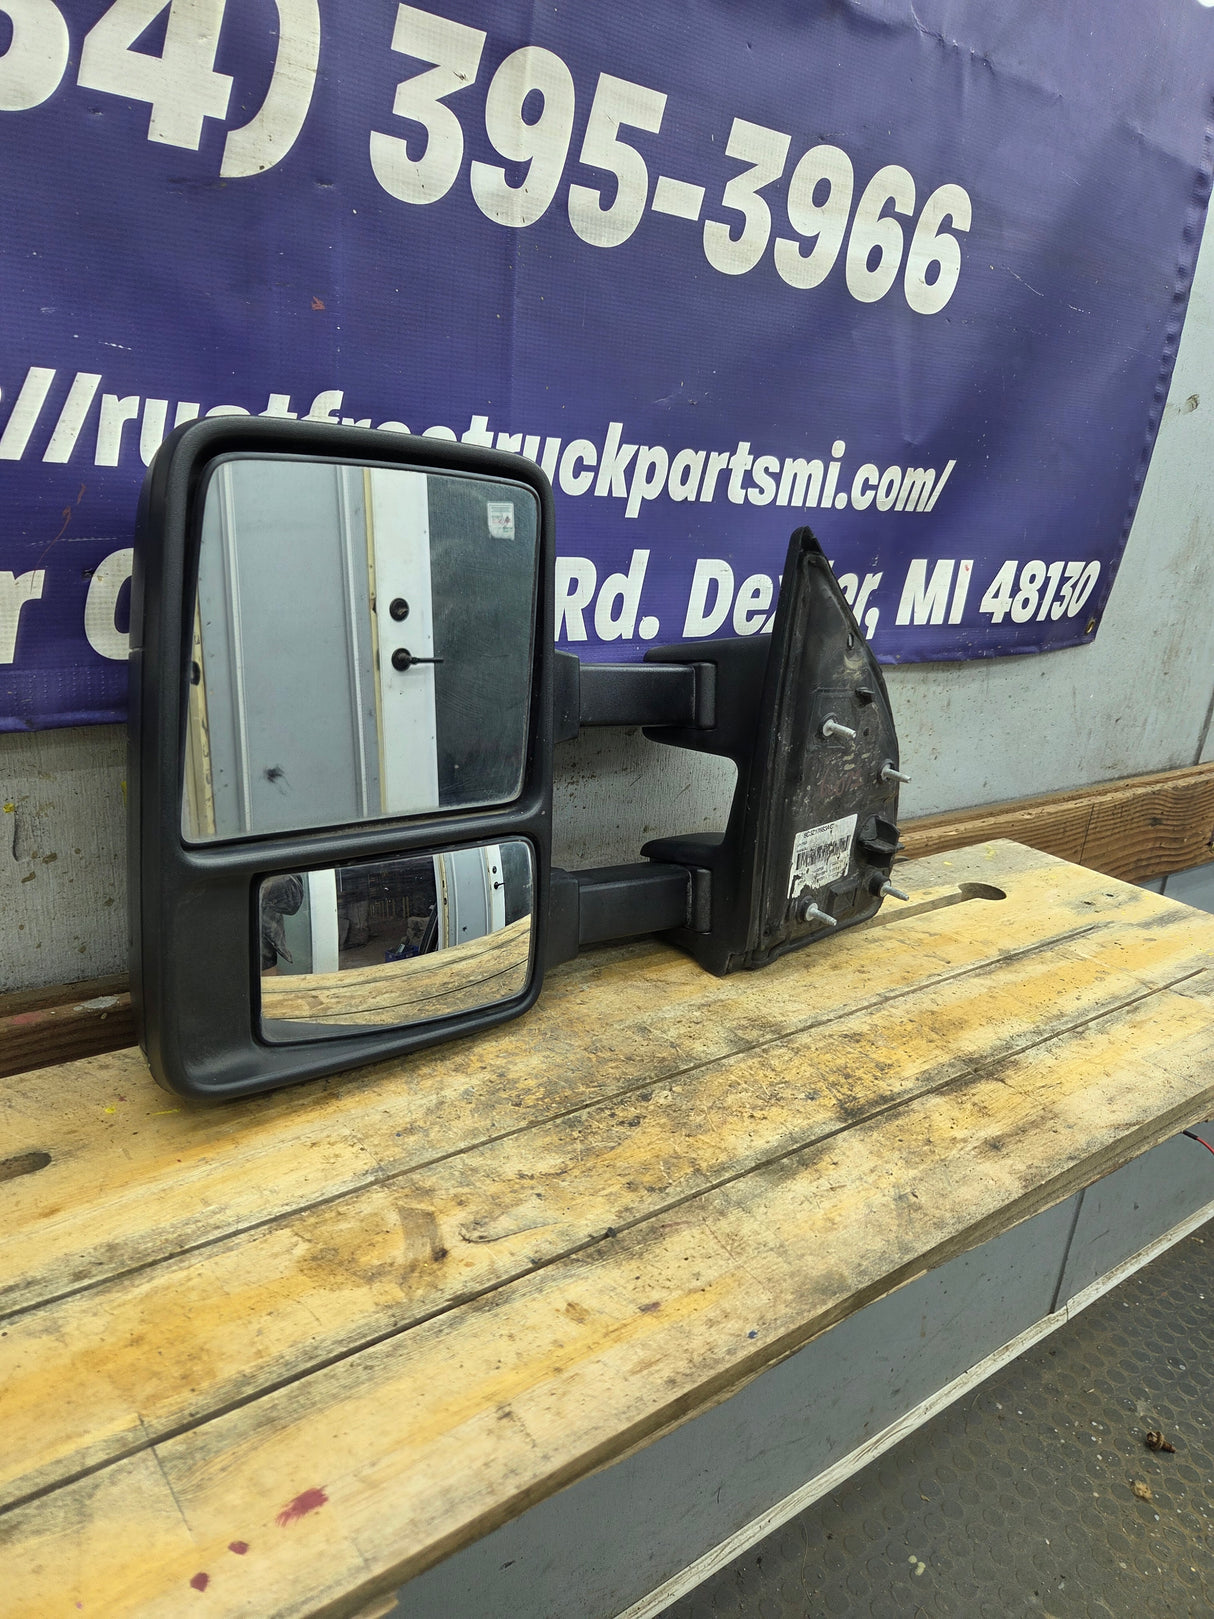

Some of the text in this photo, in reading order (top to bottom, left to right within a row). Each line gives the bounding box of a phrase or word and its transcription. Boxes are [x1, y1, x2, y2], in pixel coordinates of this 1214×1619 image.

[0, 0, 973, 315] 4) 395-3966
[554, 548, 660, 642] Rd.
[682, 558, 884, 640] Der,
[895, 558, 974, 626] MI
[978, 559, 1101, 624] 48130
